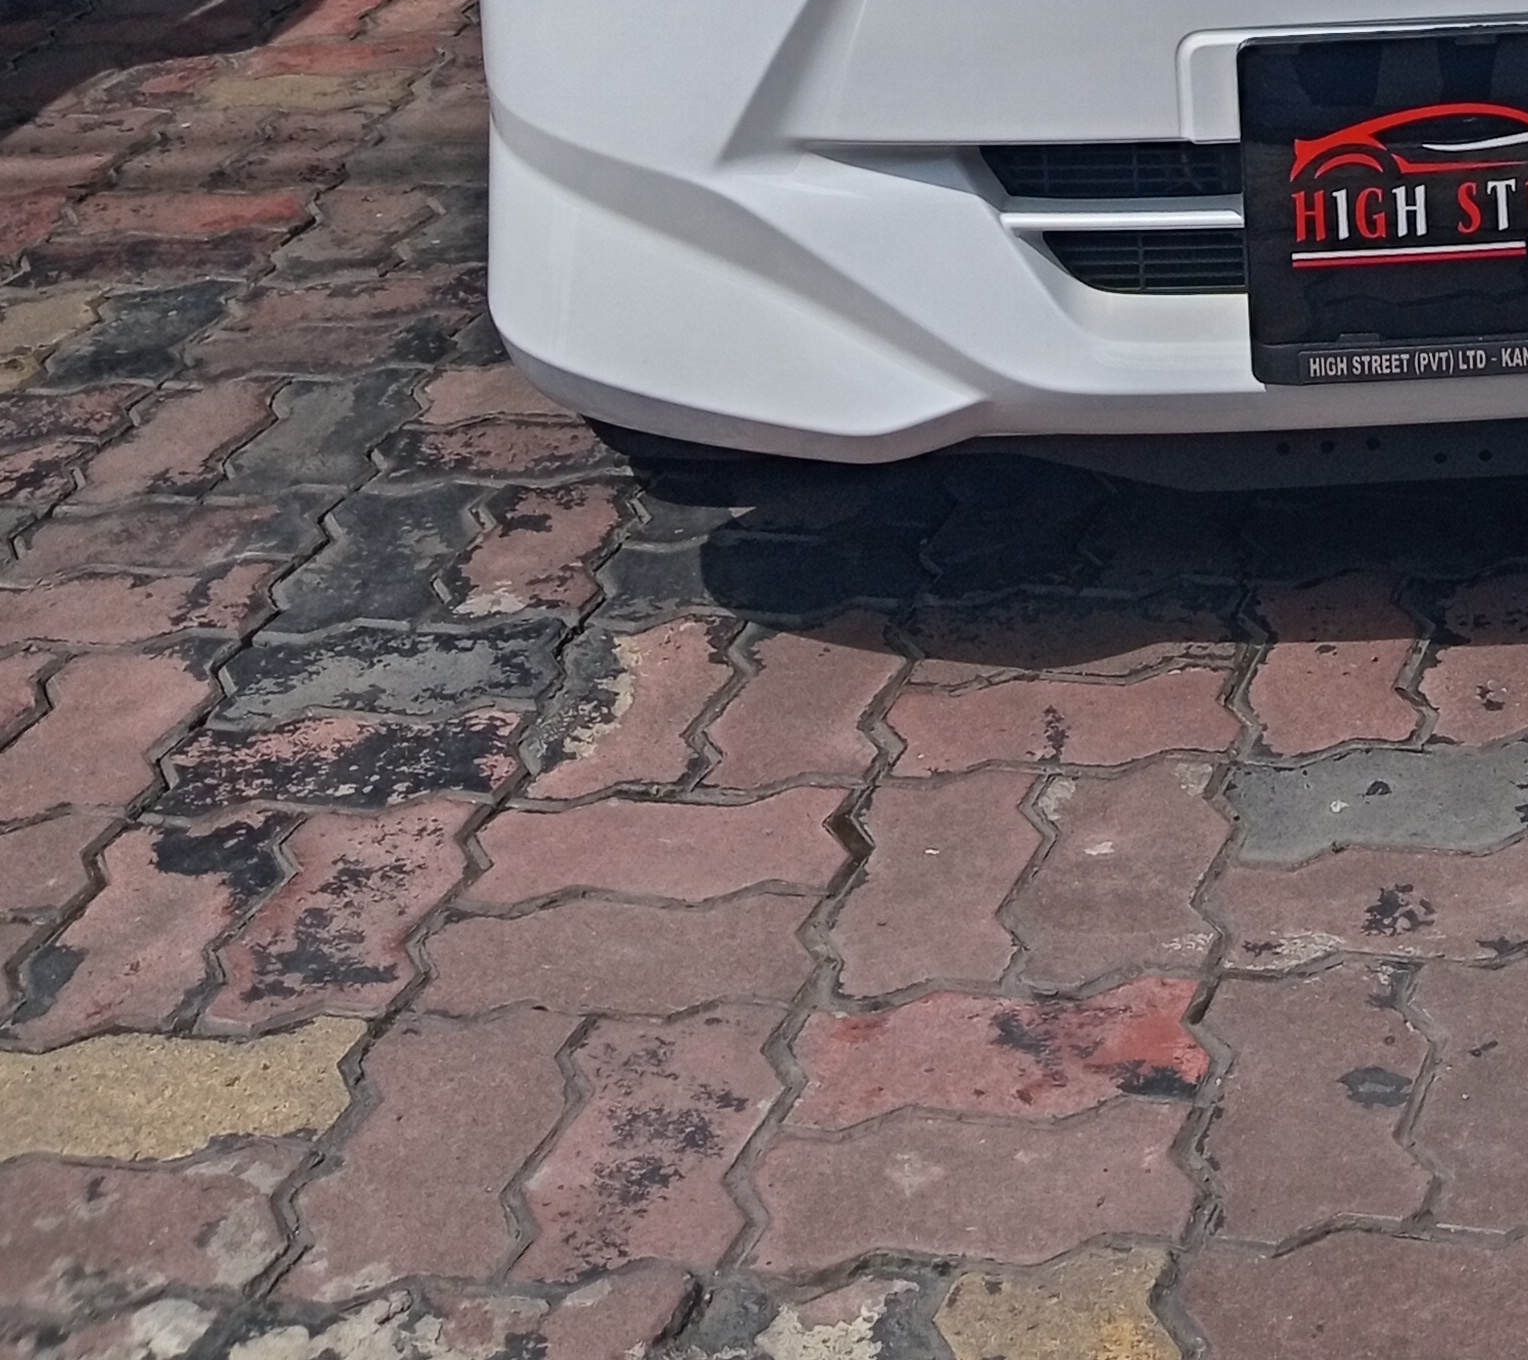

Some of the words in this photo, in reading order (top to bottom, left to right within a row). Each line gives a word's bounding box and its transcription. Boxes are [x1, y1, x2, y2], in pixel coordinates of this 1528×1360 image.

[1291, 185, 1429, 243] HIGH
[1309, 354, 1348, 378] HIGH
[1352, 353, 1411, 376] STREET
[1414, 348, 1454, 375] (PVT)
[1458, 349, 1487, 371] LTD
